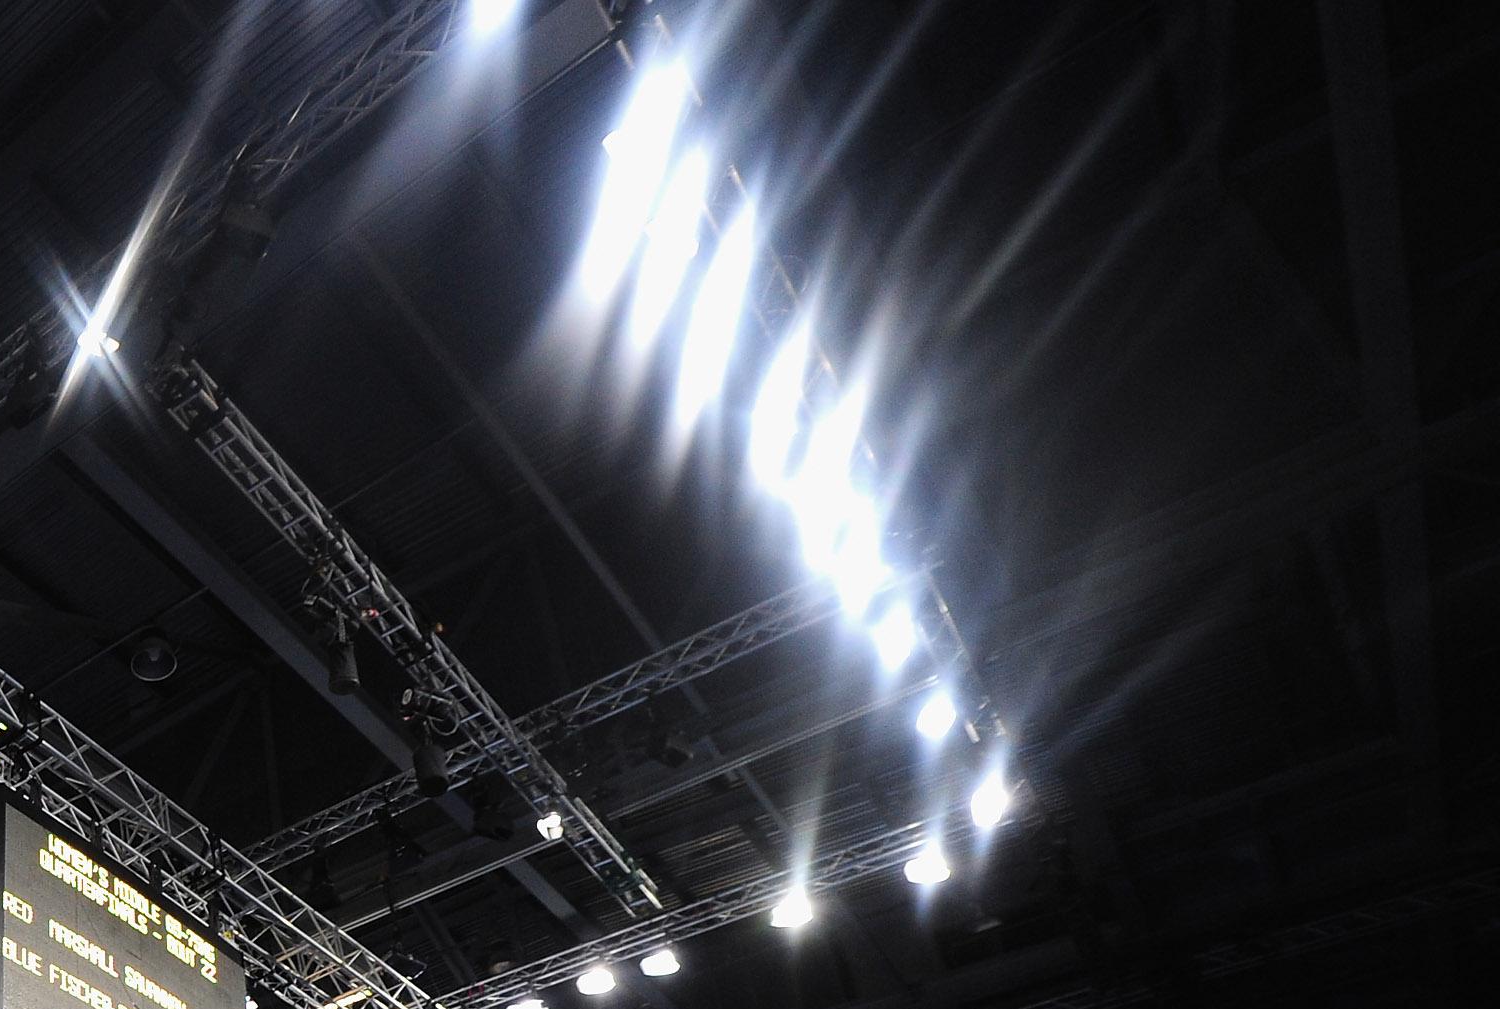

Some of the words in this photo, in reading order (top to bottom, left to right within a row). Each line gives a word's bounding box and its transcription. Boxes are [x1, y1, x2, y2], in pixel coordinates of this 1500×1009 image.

[39, 849, 148, 934] QUARTERFINALS
[167, 934, 196, 967] BOUT
[201, 958, 217, 983] 22
[49, 833, 110, 888] WOMEN'S
[114, 878, 161, 925] MIDDLE
[2, 937, 43, 976] BLUE
[3, 891, 33, 924] RED
[49, 919, 119, 978] MARSHALL
